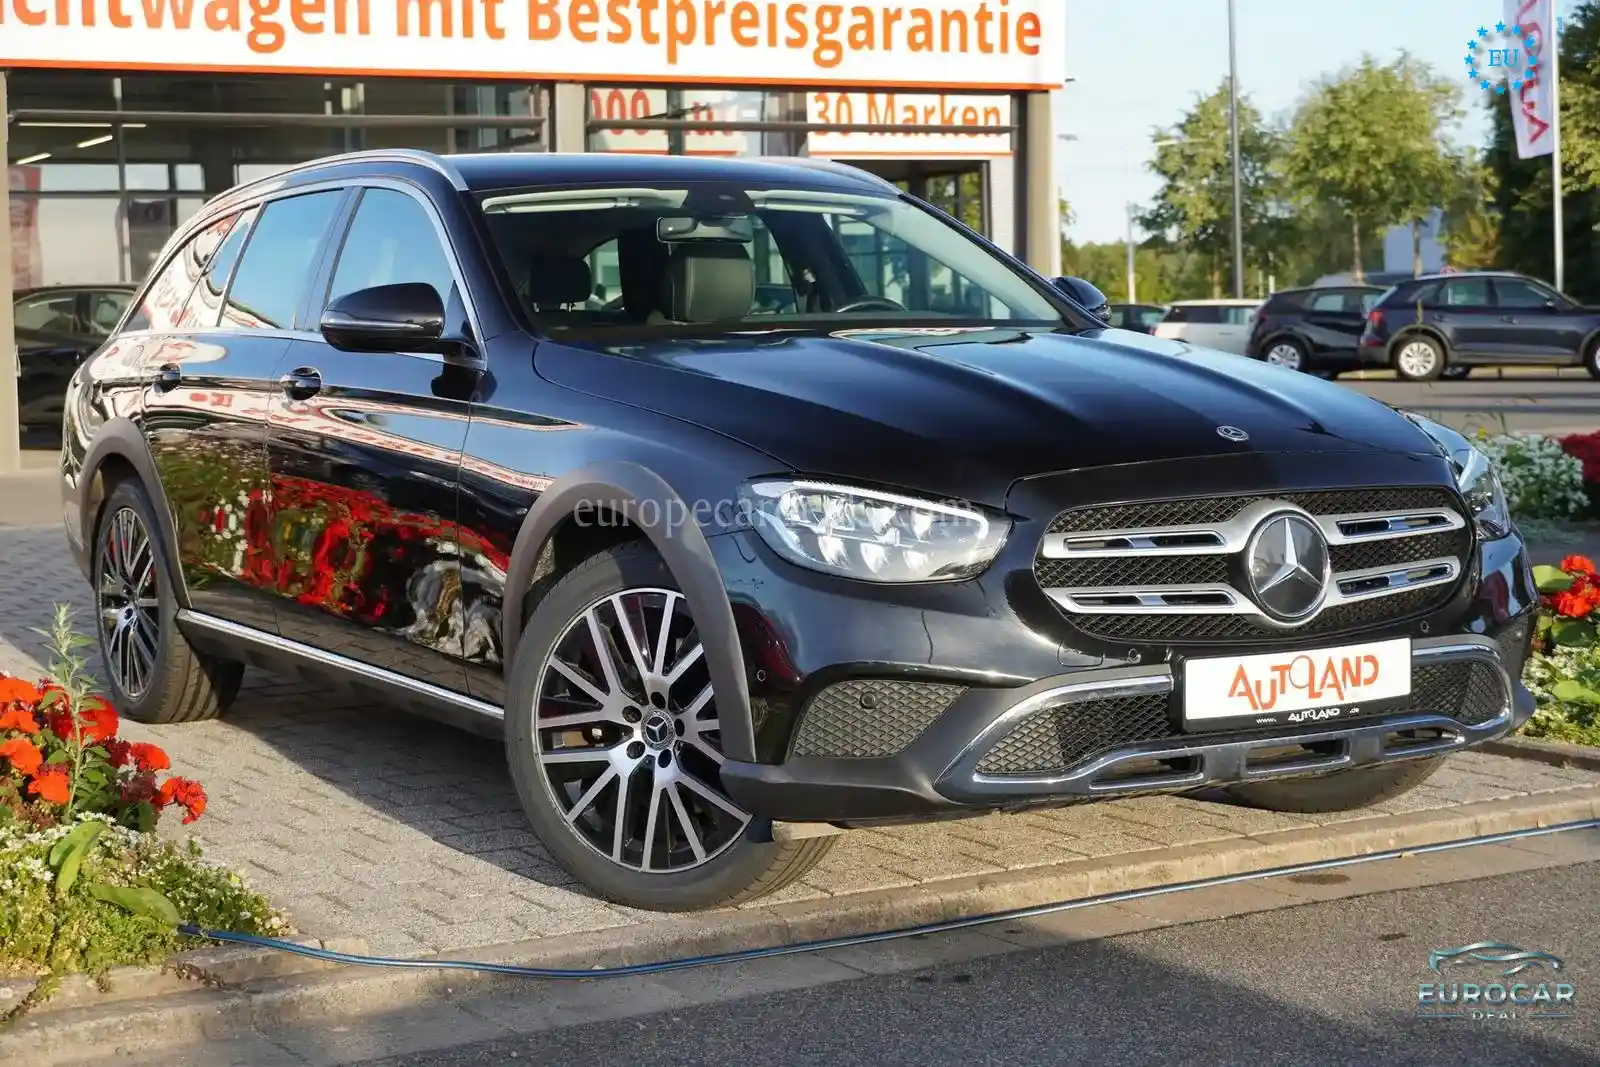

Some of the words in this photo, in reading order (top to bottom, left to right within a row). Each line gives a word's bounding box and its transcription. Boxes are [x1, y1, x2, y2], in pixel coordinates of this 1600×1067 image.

[397, 0, 505, 40] mit
[528, 0, 1041, 68] Bestpreisgarantie
[813, 92, 853, 136] 30
[867, 92, 1001, 138] Marken
[1228, 654, 1380, 711] AUTOLAND
